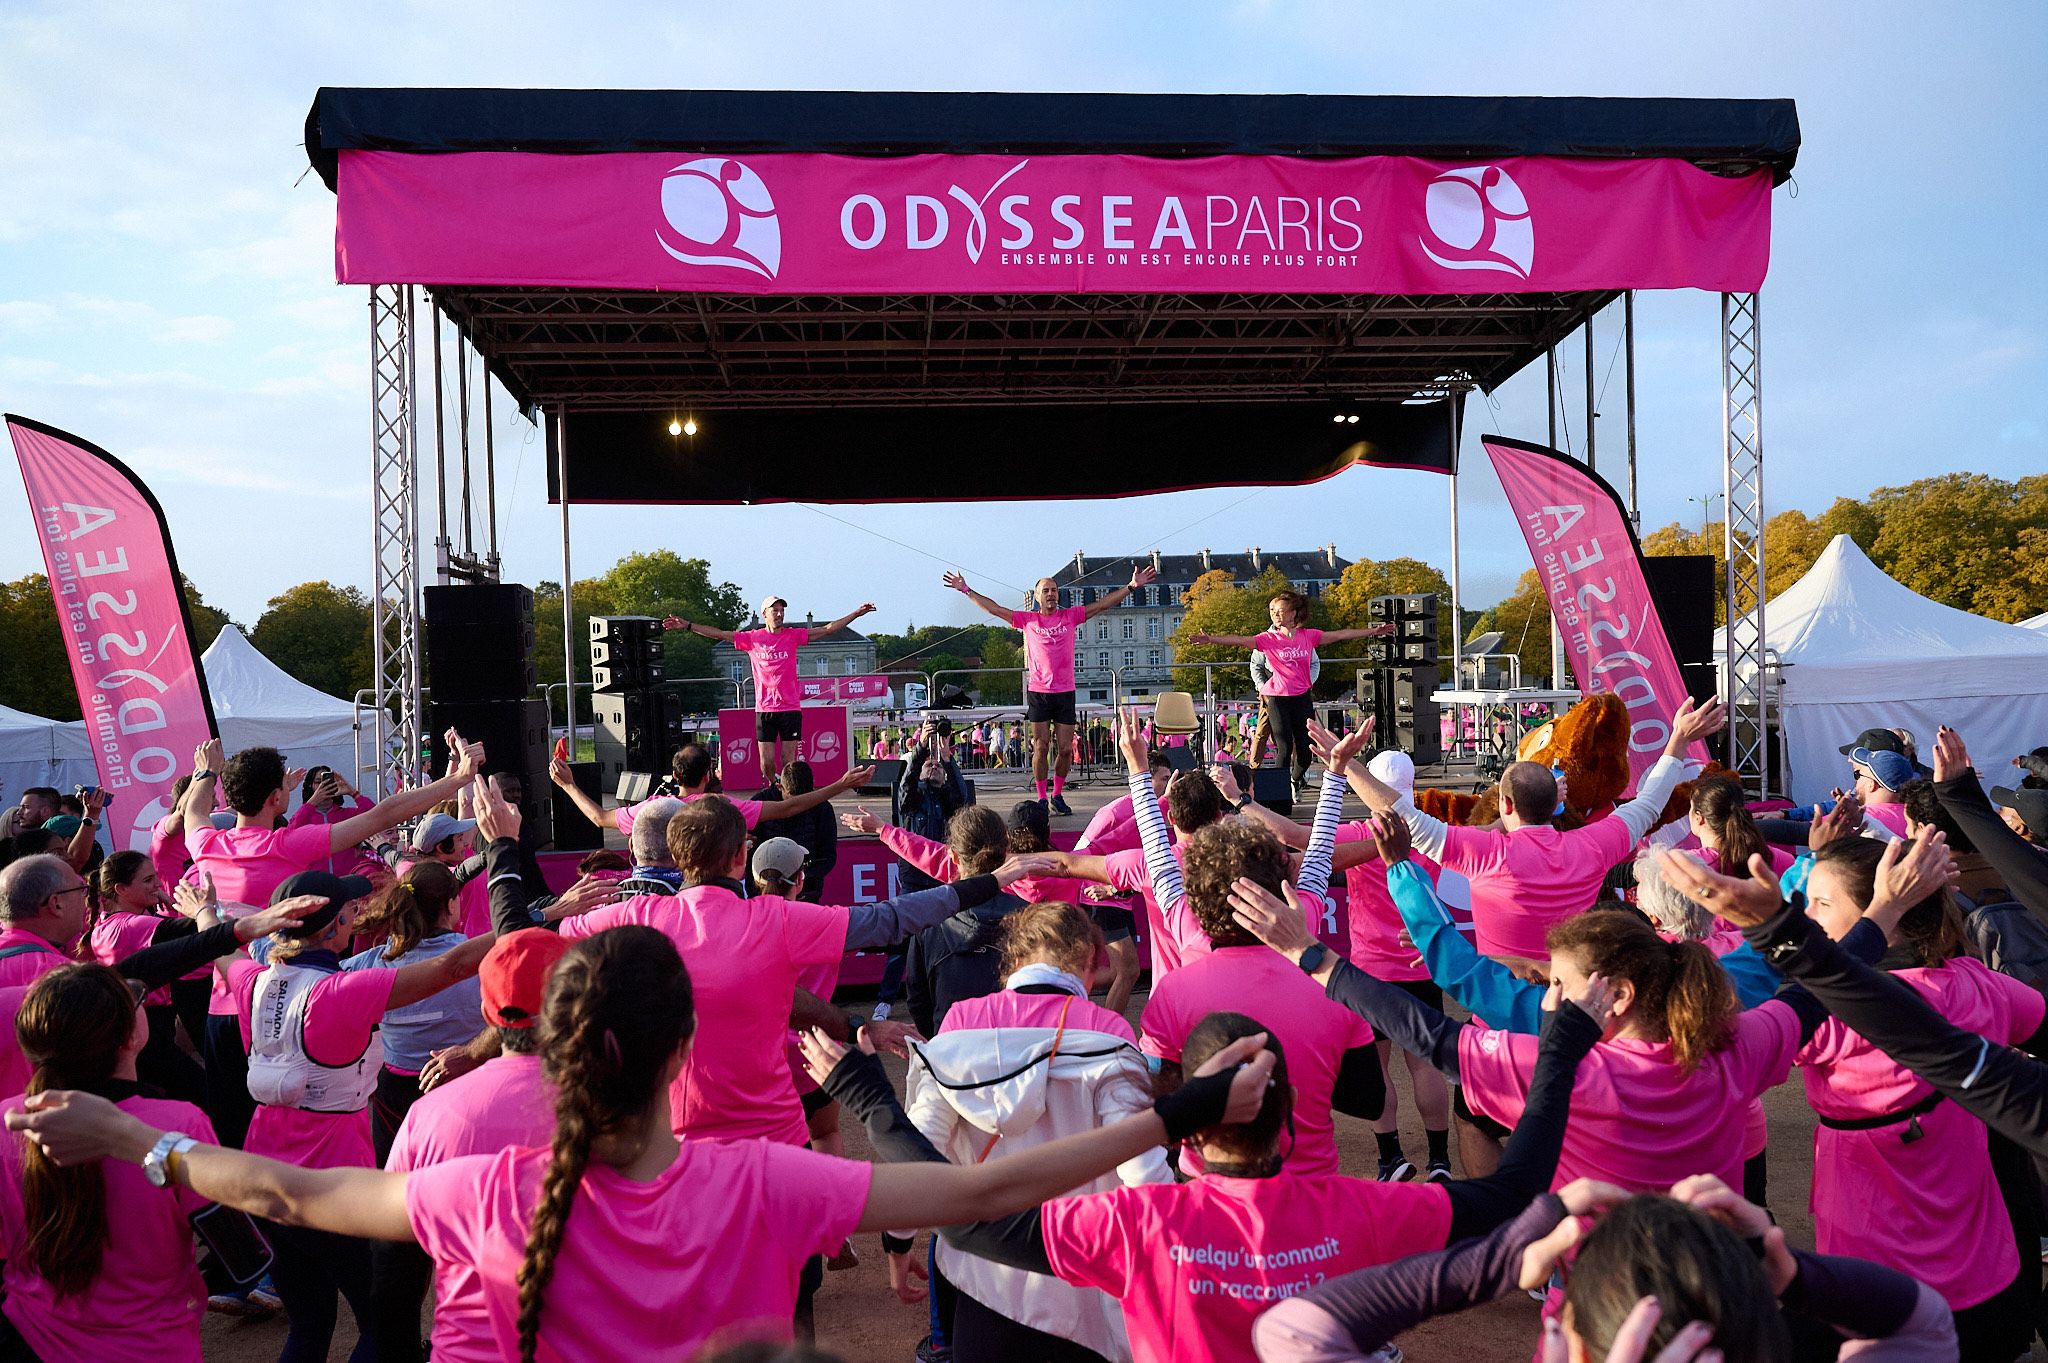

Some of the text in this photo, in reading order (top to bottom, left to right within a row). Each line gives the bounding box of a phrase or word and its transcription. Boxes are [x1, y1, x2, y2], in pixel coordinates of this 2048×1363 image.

[1206, 195, 1363, 252] PARIS
[1001, 253, 1359, 267] ENSEMBLE ON EST ENCORE PLUS FORT
[273, 980, 288, 1040] SALOMON
[1188, 1278, 1214, 1295] un
[1219, 1274, 1311, 1301] raccourci
